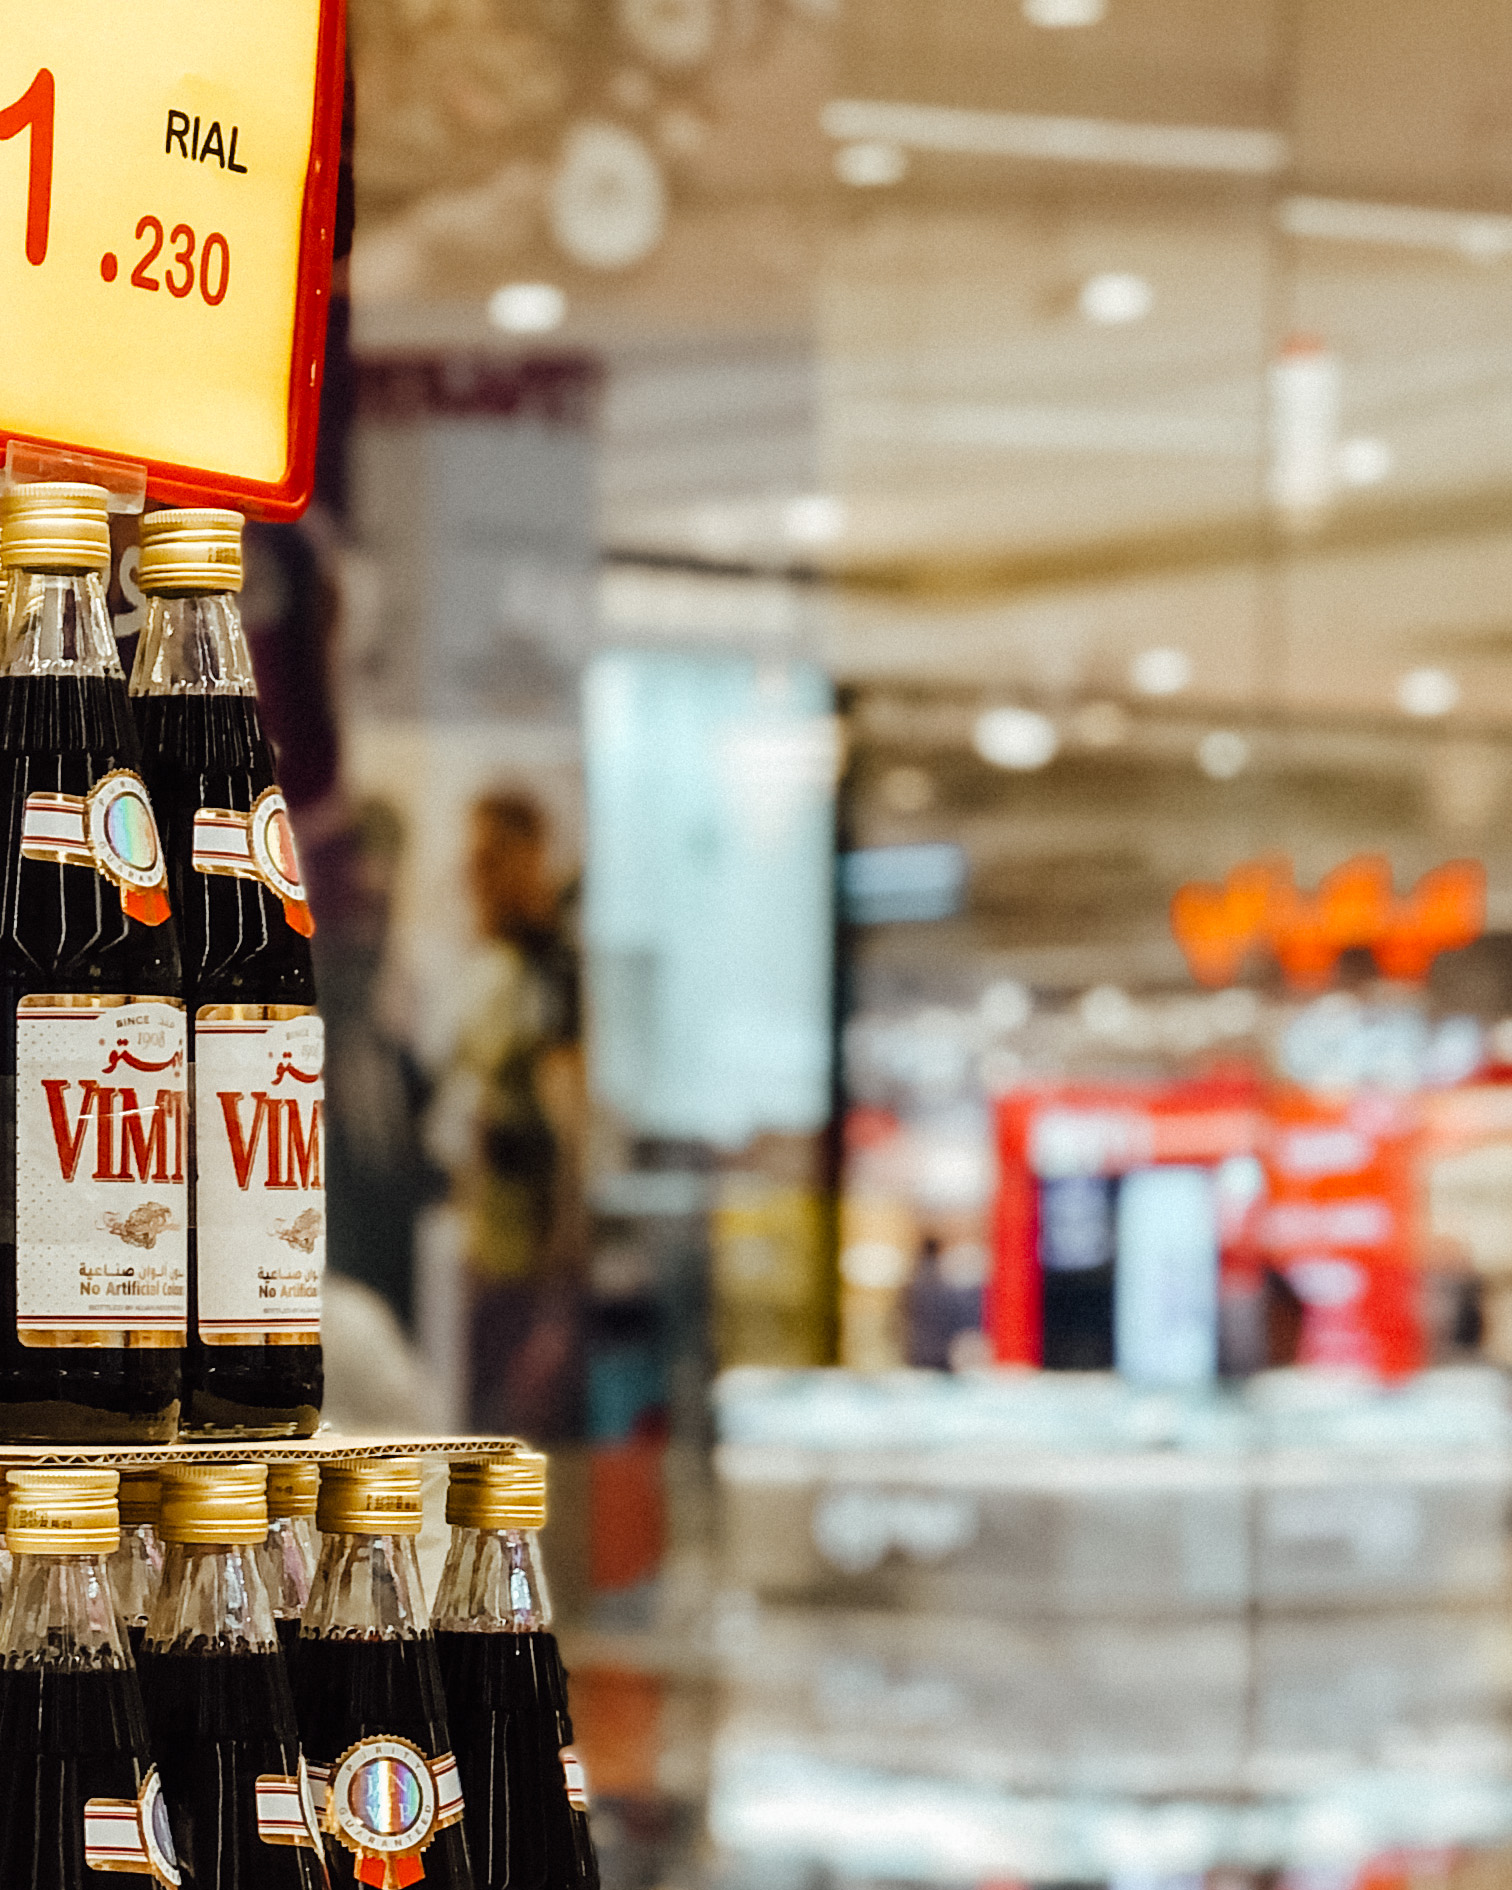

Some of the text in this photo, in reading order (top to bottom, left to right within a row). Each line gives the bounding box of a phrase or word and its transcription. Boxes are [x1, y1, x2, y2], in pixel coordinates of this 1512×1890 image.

[165, 109, 248, 174] RIAL
[41, 1079, 184, 1185] VIMT
[216, 1091, 325, 1191] VIM
[80, 1281, 100, 1296] No
[106, 1280, 159, 1296] Artificial
[259, 1285, 276, 1298] No
[338, 1804, 432, 1847] GUARANTEED
